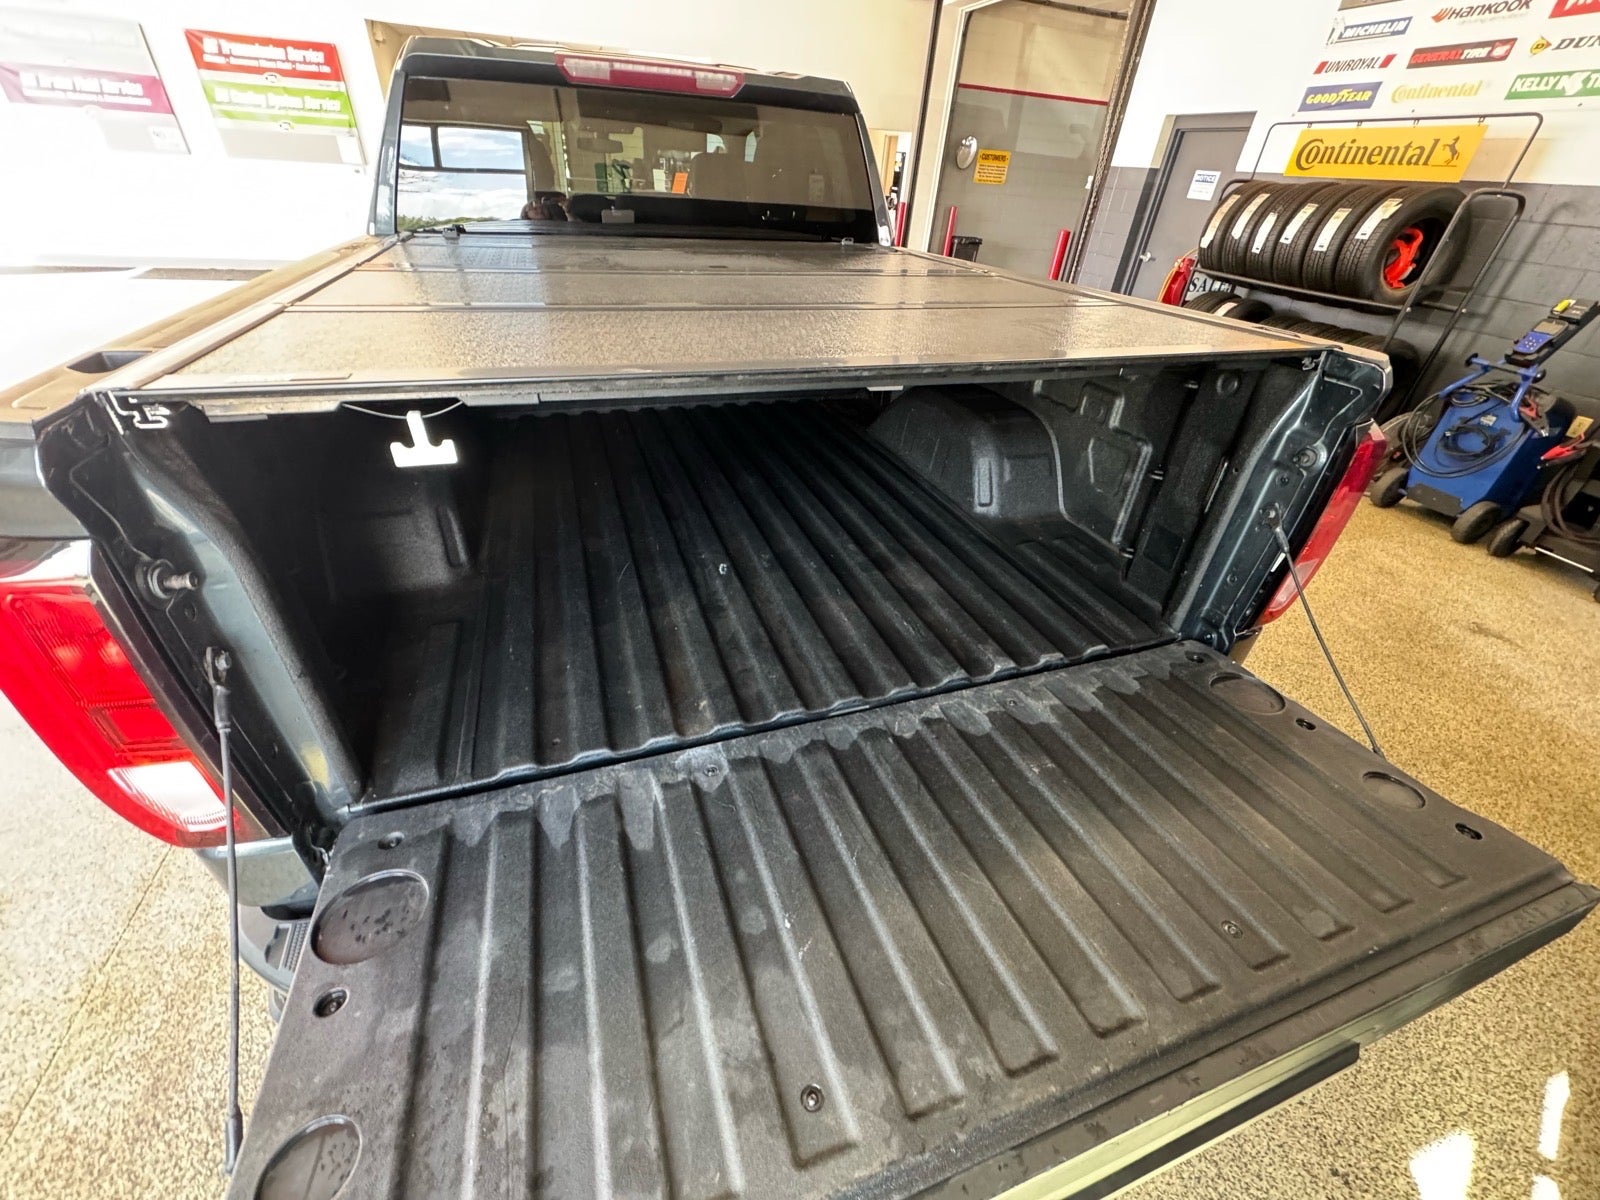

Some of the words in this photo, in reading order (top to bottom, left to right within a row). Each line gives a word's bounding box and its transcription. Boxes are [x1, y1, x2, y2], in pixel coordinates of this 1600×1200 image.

[1342, 19, 1410, 38] MICHELIN
[1409, 49, 1462, 64] GENERAL
[1460, 47, 1493, 60] TIRE
[1325, 57, 1381, 73] UNIROYAL
[1391, 80, 1484, 103] Continental
[1511, 75, 1561, 92] KELLY
[1306, 88, 1373, 105] GOODYEAR
[1295, 138, 1441, 171] Continental
